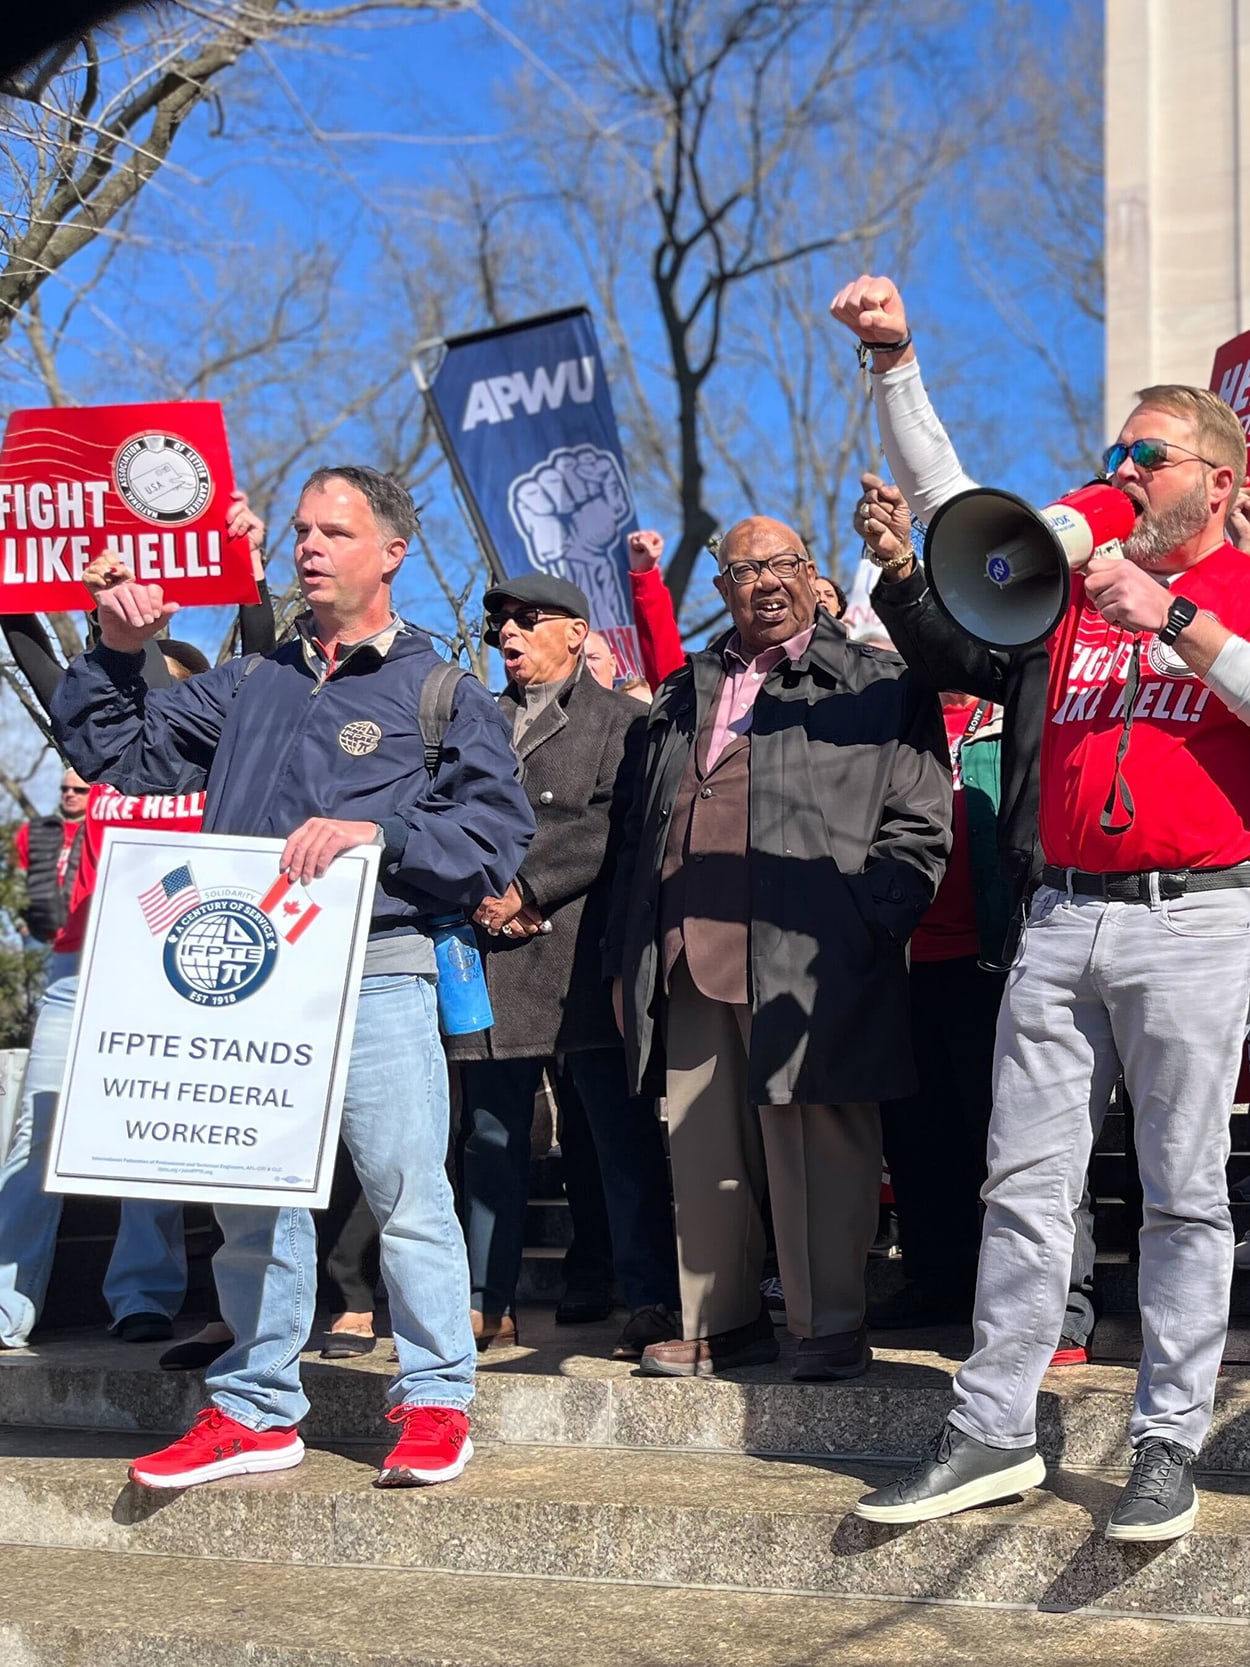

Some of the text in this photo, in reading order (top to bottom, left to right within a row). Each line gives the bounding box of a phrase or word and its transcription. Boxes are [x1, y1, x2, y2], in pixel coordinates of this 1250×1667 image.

[462, 356, 595, 432] APWU
[173, 442, 186, 453] OF
[119, 442, 142, 488] ASSOCIATION
[186, 451, 207, 479] LETTER
[125, 491, 159, 519] NATIONAL
[4, 530, 222, 585] LIKE HELL!
[968, 707, 983, 732] SONY
[204, 889, 257, 901] SOLIDARITY
[176, 901, 276, 939] A CENTURY OF SERVICE
[181, 944, 263, 961] IFPTE
[189, 991, 236, 1005] EST 1918
[98, 1031, 314, 1067] IFPTE STANDS
[102, 1077, 294, 1108] WITH FEDERAL
[125, 1120, 259, 1148] WORKERS
